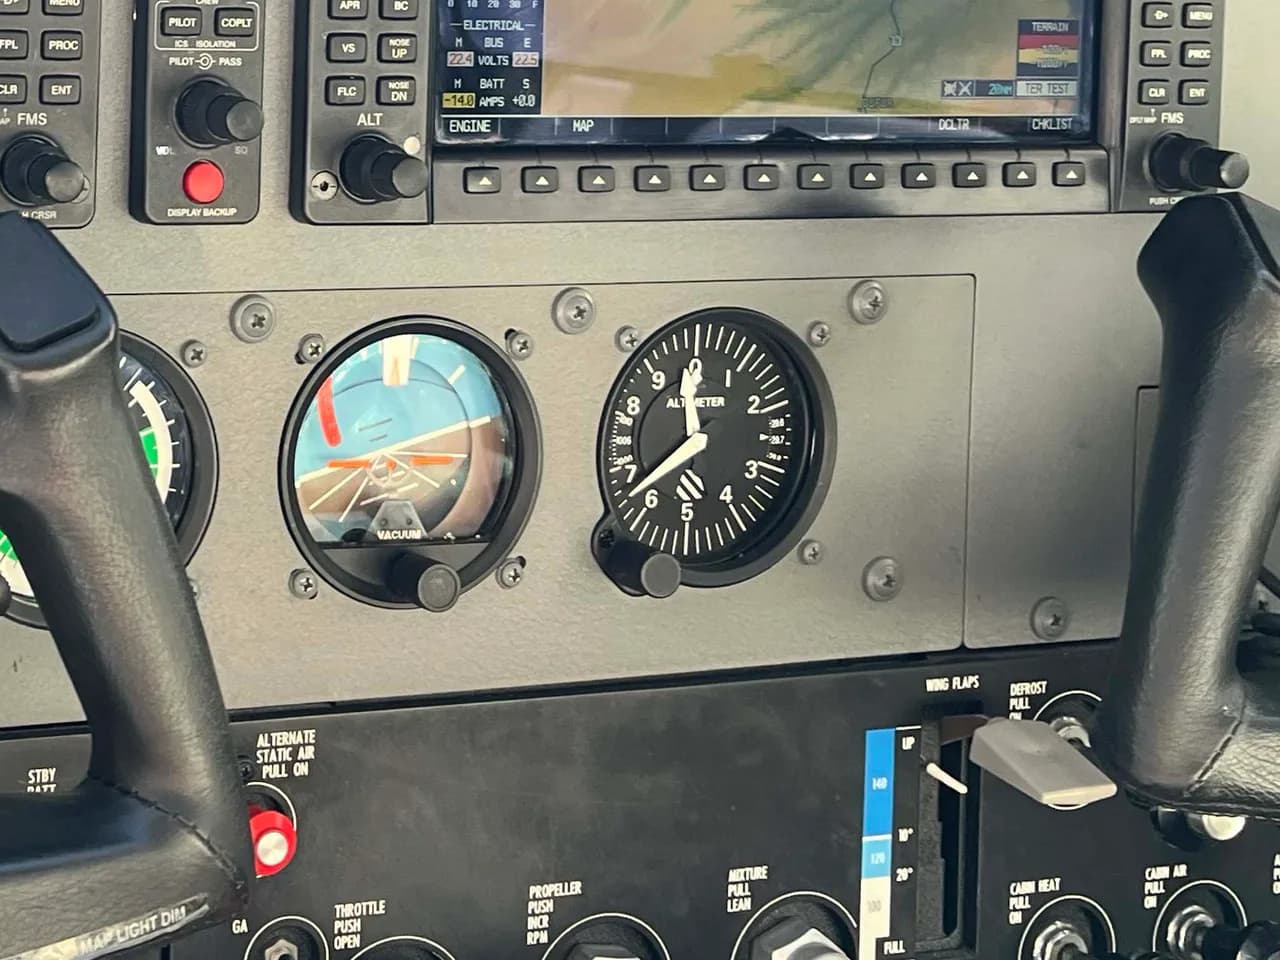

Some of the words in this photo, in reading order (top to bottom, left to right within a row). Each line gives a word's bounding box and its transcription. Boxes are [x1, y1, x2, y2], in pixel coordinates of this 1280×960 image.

[169, 17, 196, 28] PILOT
[221, 17, 252, 28] COPLT
[464, 20, 524, 31] ELECTRICAL
[49, 40, 78, 51] PROC
[17, 113, 47, 125] FMS
[357, 113, 383, 126] ALT
[573, 120, 594, 132] MAP
[449, 120, 491, 133] ENGINE
[168, 208, 201, 217] DISPLAY
[203, 208, 237, 217] BACKUP
[626, 397, 640, 414] 8
[681, 503, 693, 521] 5
[377, 529, 421, 540] VACUUM
[952, 675, 979, 690] FLAPS
[1010, 681, 1047, 696] DEFROST
[257, 730, 316, 748] ALTERNATE
[256, 748, 293, 763] STATIC
[297, 745, 314, 760] AIR
[28, 768, 56, 784] STBY
[262, 763, 288, 778] PULL
[293, 761, 308, 776] ON
[529, 881, 582, 898] PROPELLER
[334, 900, 386, 918] THROTTLE
